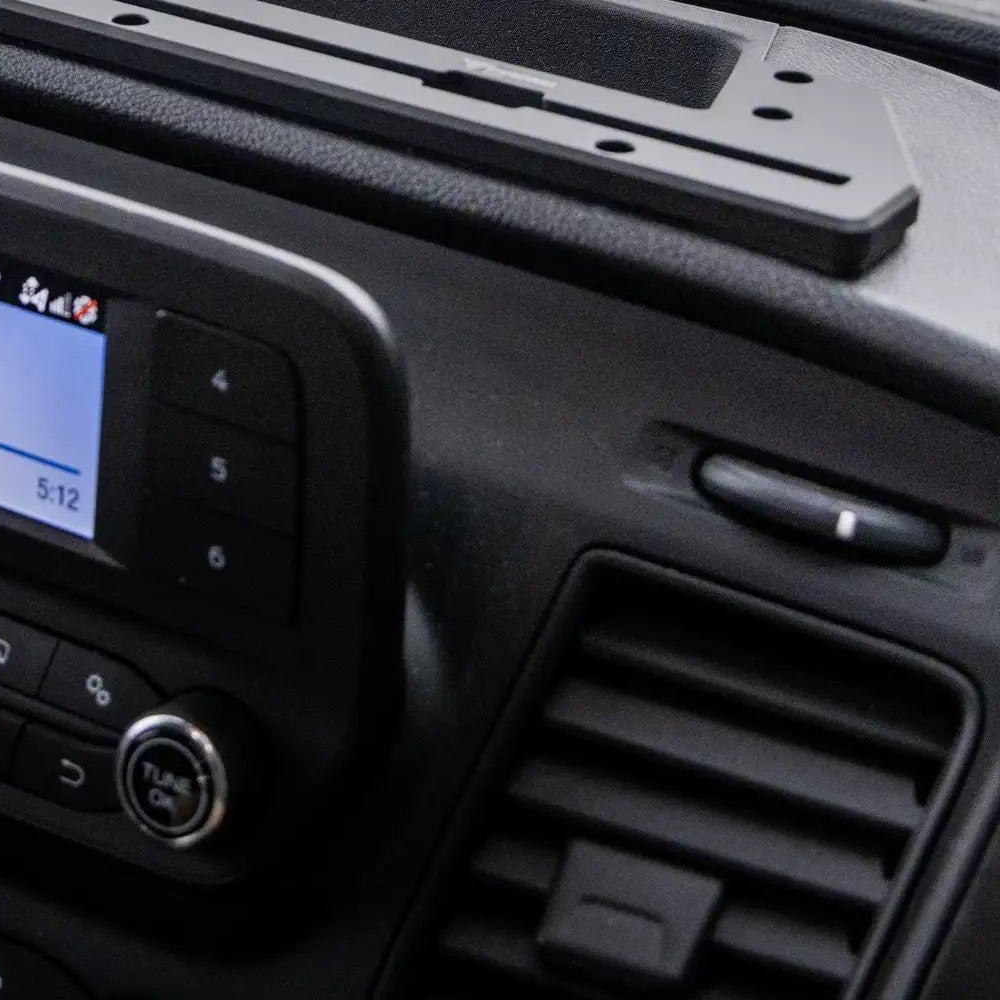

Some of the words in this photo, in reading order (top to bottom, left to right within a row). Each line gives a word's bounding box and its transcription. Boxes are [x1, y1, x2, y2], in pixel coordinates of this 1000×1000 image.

[209, 455, 229, 484] 5
[37, 477, 80, 512] 5:12
[207, 544, 227, 571] 6
[141, 760, 193, 798] TUNE
